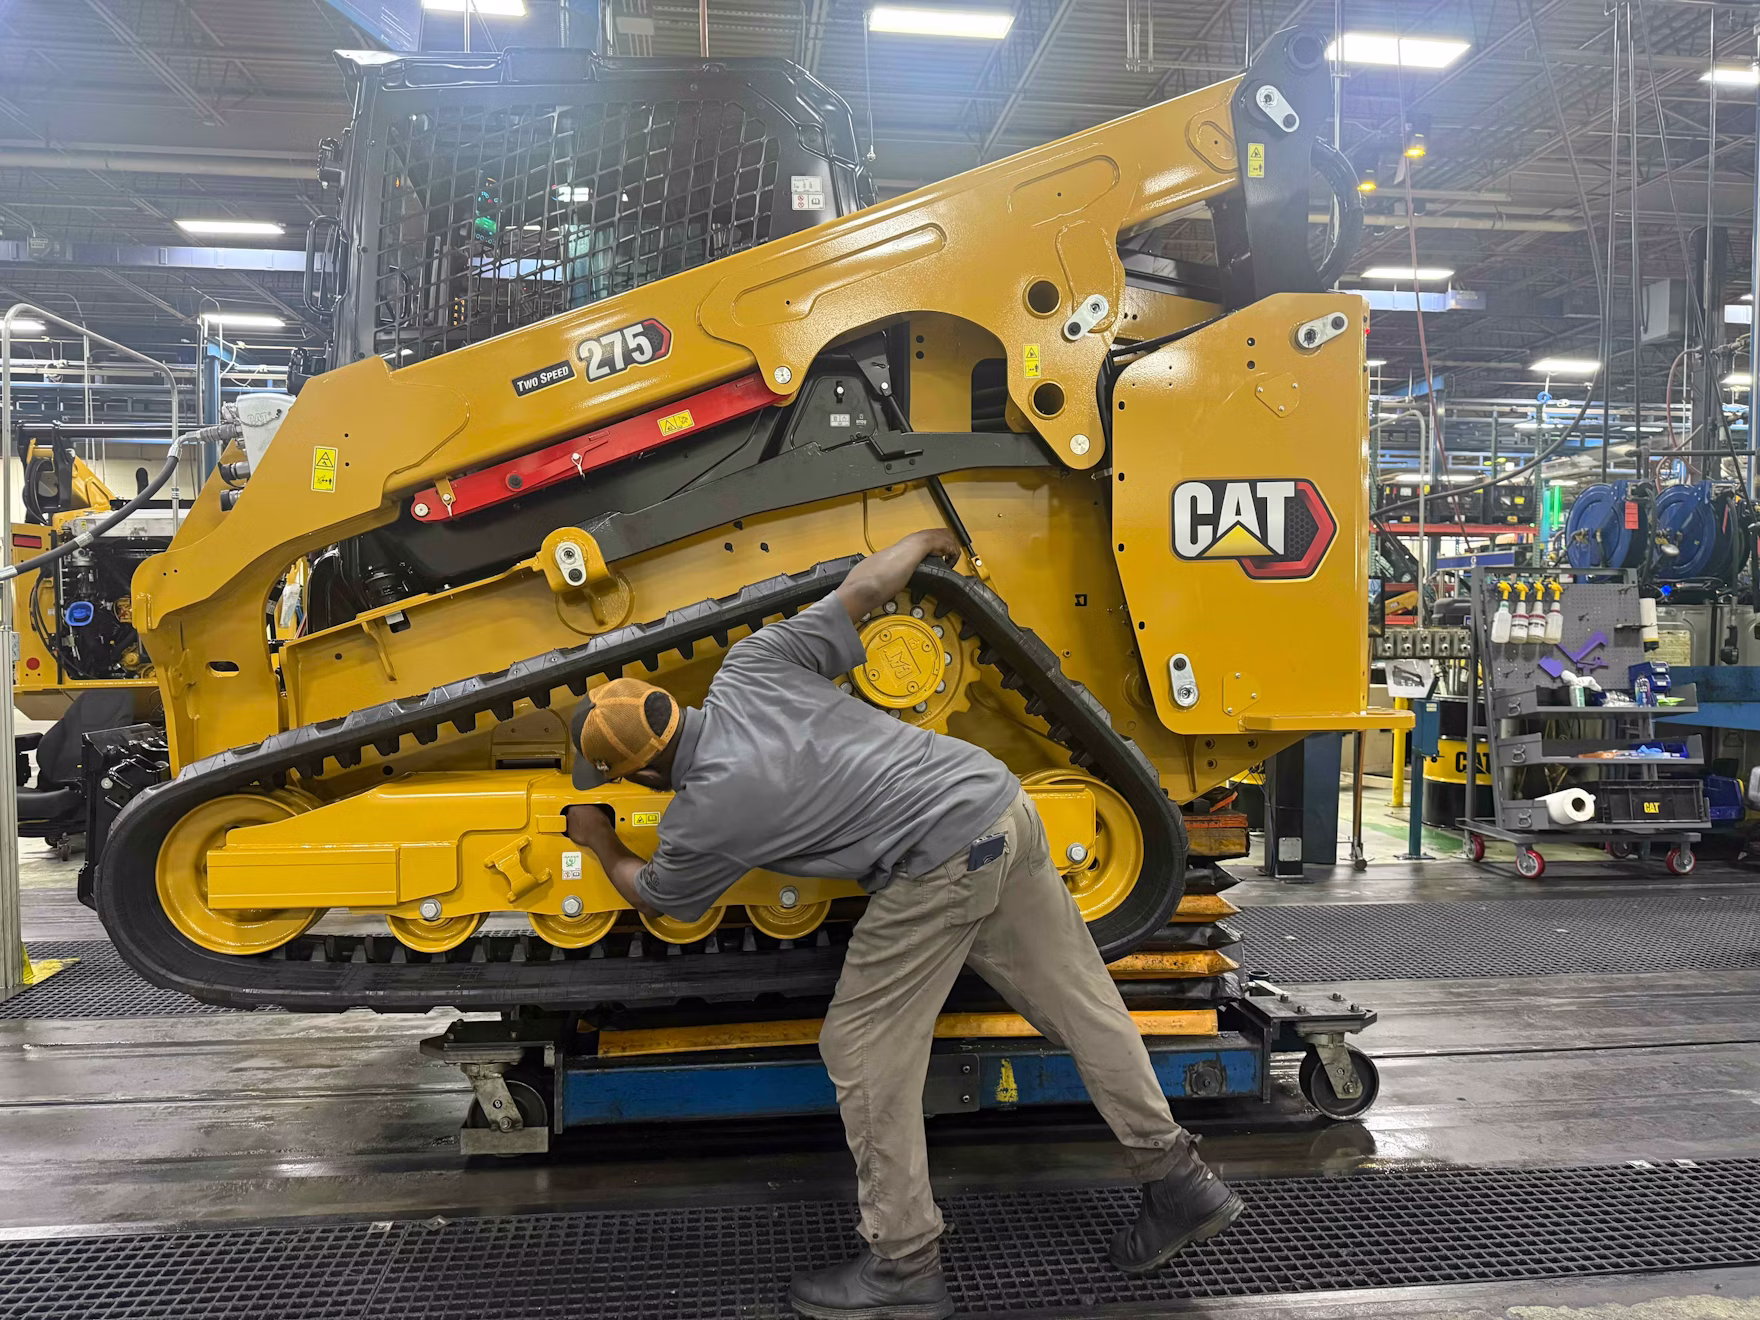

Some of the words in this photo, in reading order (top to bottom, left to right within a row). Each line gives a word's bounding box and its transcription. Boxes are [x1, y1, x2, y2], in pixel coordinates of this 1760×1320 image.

[579, 323, 653, 380] 275
[1174, 481, 1295, 558] CAT
[1643, 801, 1661, 814] CAT
